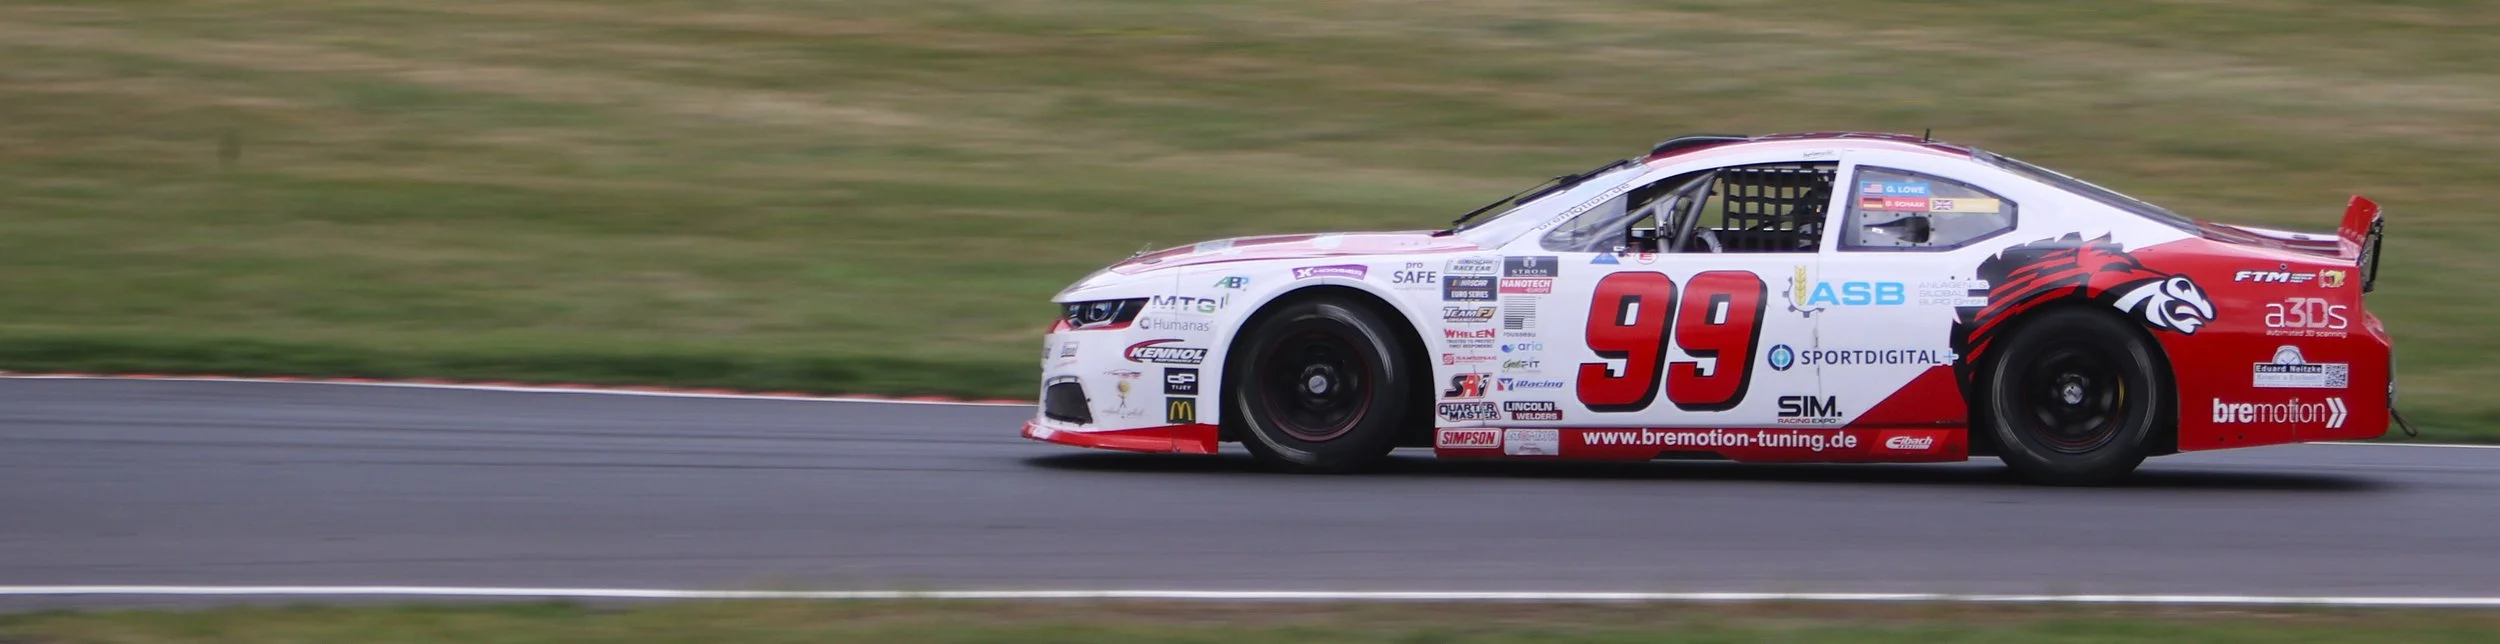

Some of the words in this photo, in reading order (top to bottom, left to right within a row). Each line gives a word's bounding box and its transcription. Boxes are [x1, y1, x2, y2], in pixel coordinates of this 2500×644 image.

[1898, 186, 1925, 194] LOWE
[1393, 271, 1437, 284] SAFE
[2234, 271, 2289, 283] FTM
[1807, 282, 1906, 305] ASB
[1152, 295, 1216, 313] MTG
[1153, 319, 1209, 331] Humanas
[1444, 328, 1496, 338] WHELEN
[1518, 341, 1543, 351] aria
[1576, 270, 1768, 413] 99
[1130, 348, 1203, 359] KENNOL
[1515, 380, 1564, 388] iRacing
[1440, 404, 1494, 414] QUARTER
[1506, 403, 1553, 411] LINCOLN
[2213, 398, 2326, 423] bremotion
[1449, 412, 1497, 420] MASTER
[1442, 432, 1495, 444] SIMPSON
[1583, 428, 1857, 451] www.bremotion-tuning.de
[1886, 436, 1933, 449] Eibach
